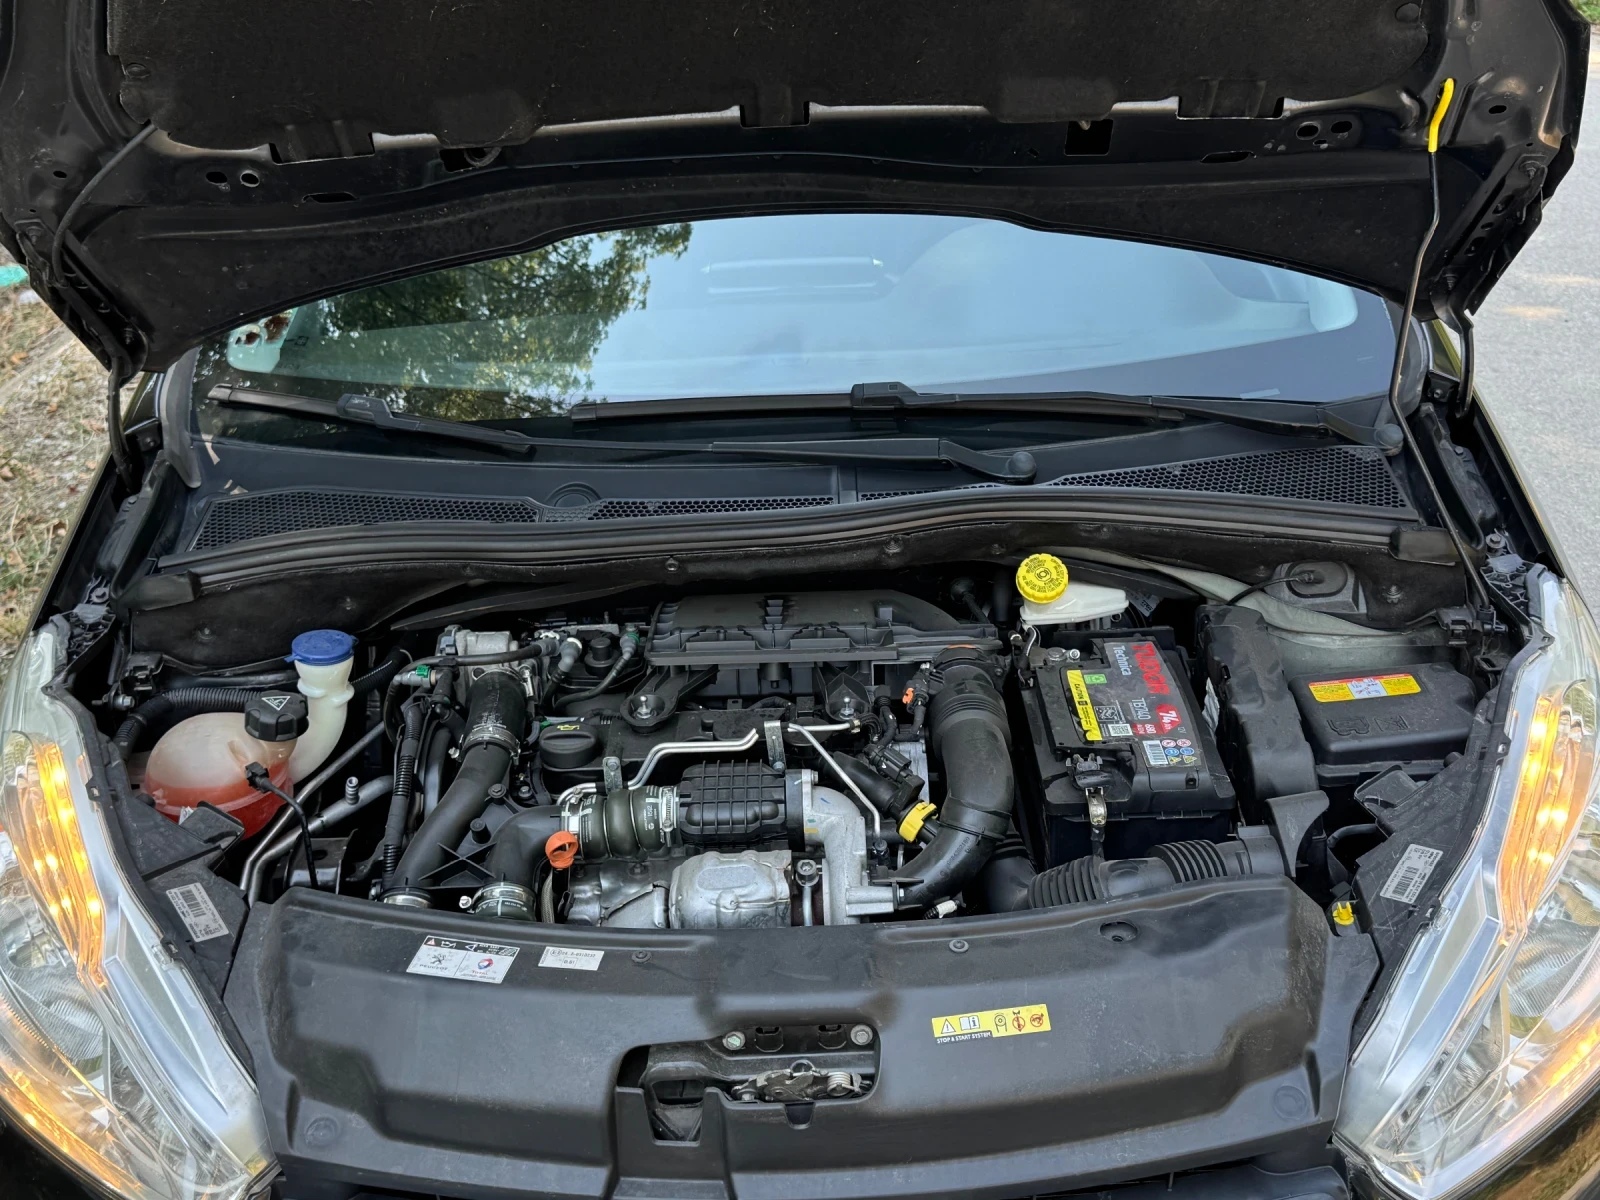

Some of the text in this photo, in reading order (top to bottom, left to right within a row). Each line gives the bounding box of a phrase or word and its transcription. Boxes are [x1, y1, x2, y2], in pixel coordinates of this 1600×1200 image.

[1113, 645, 1132, 676] Technica
[1132, 643, 1170, 695] TUDOR
[1074, 683, 1083, 700] CAUTION
[1132, 697, 1151, 720] TB740
